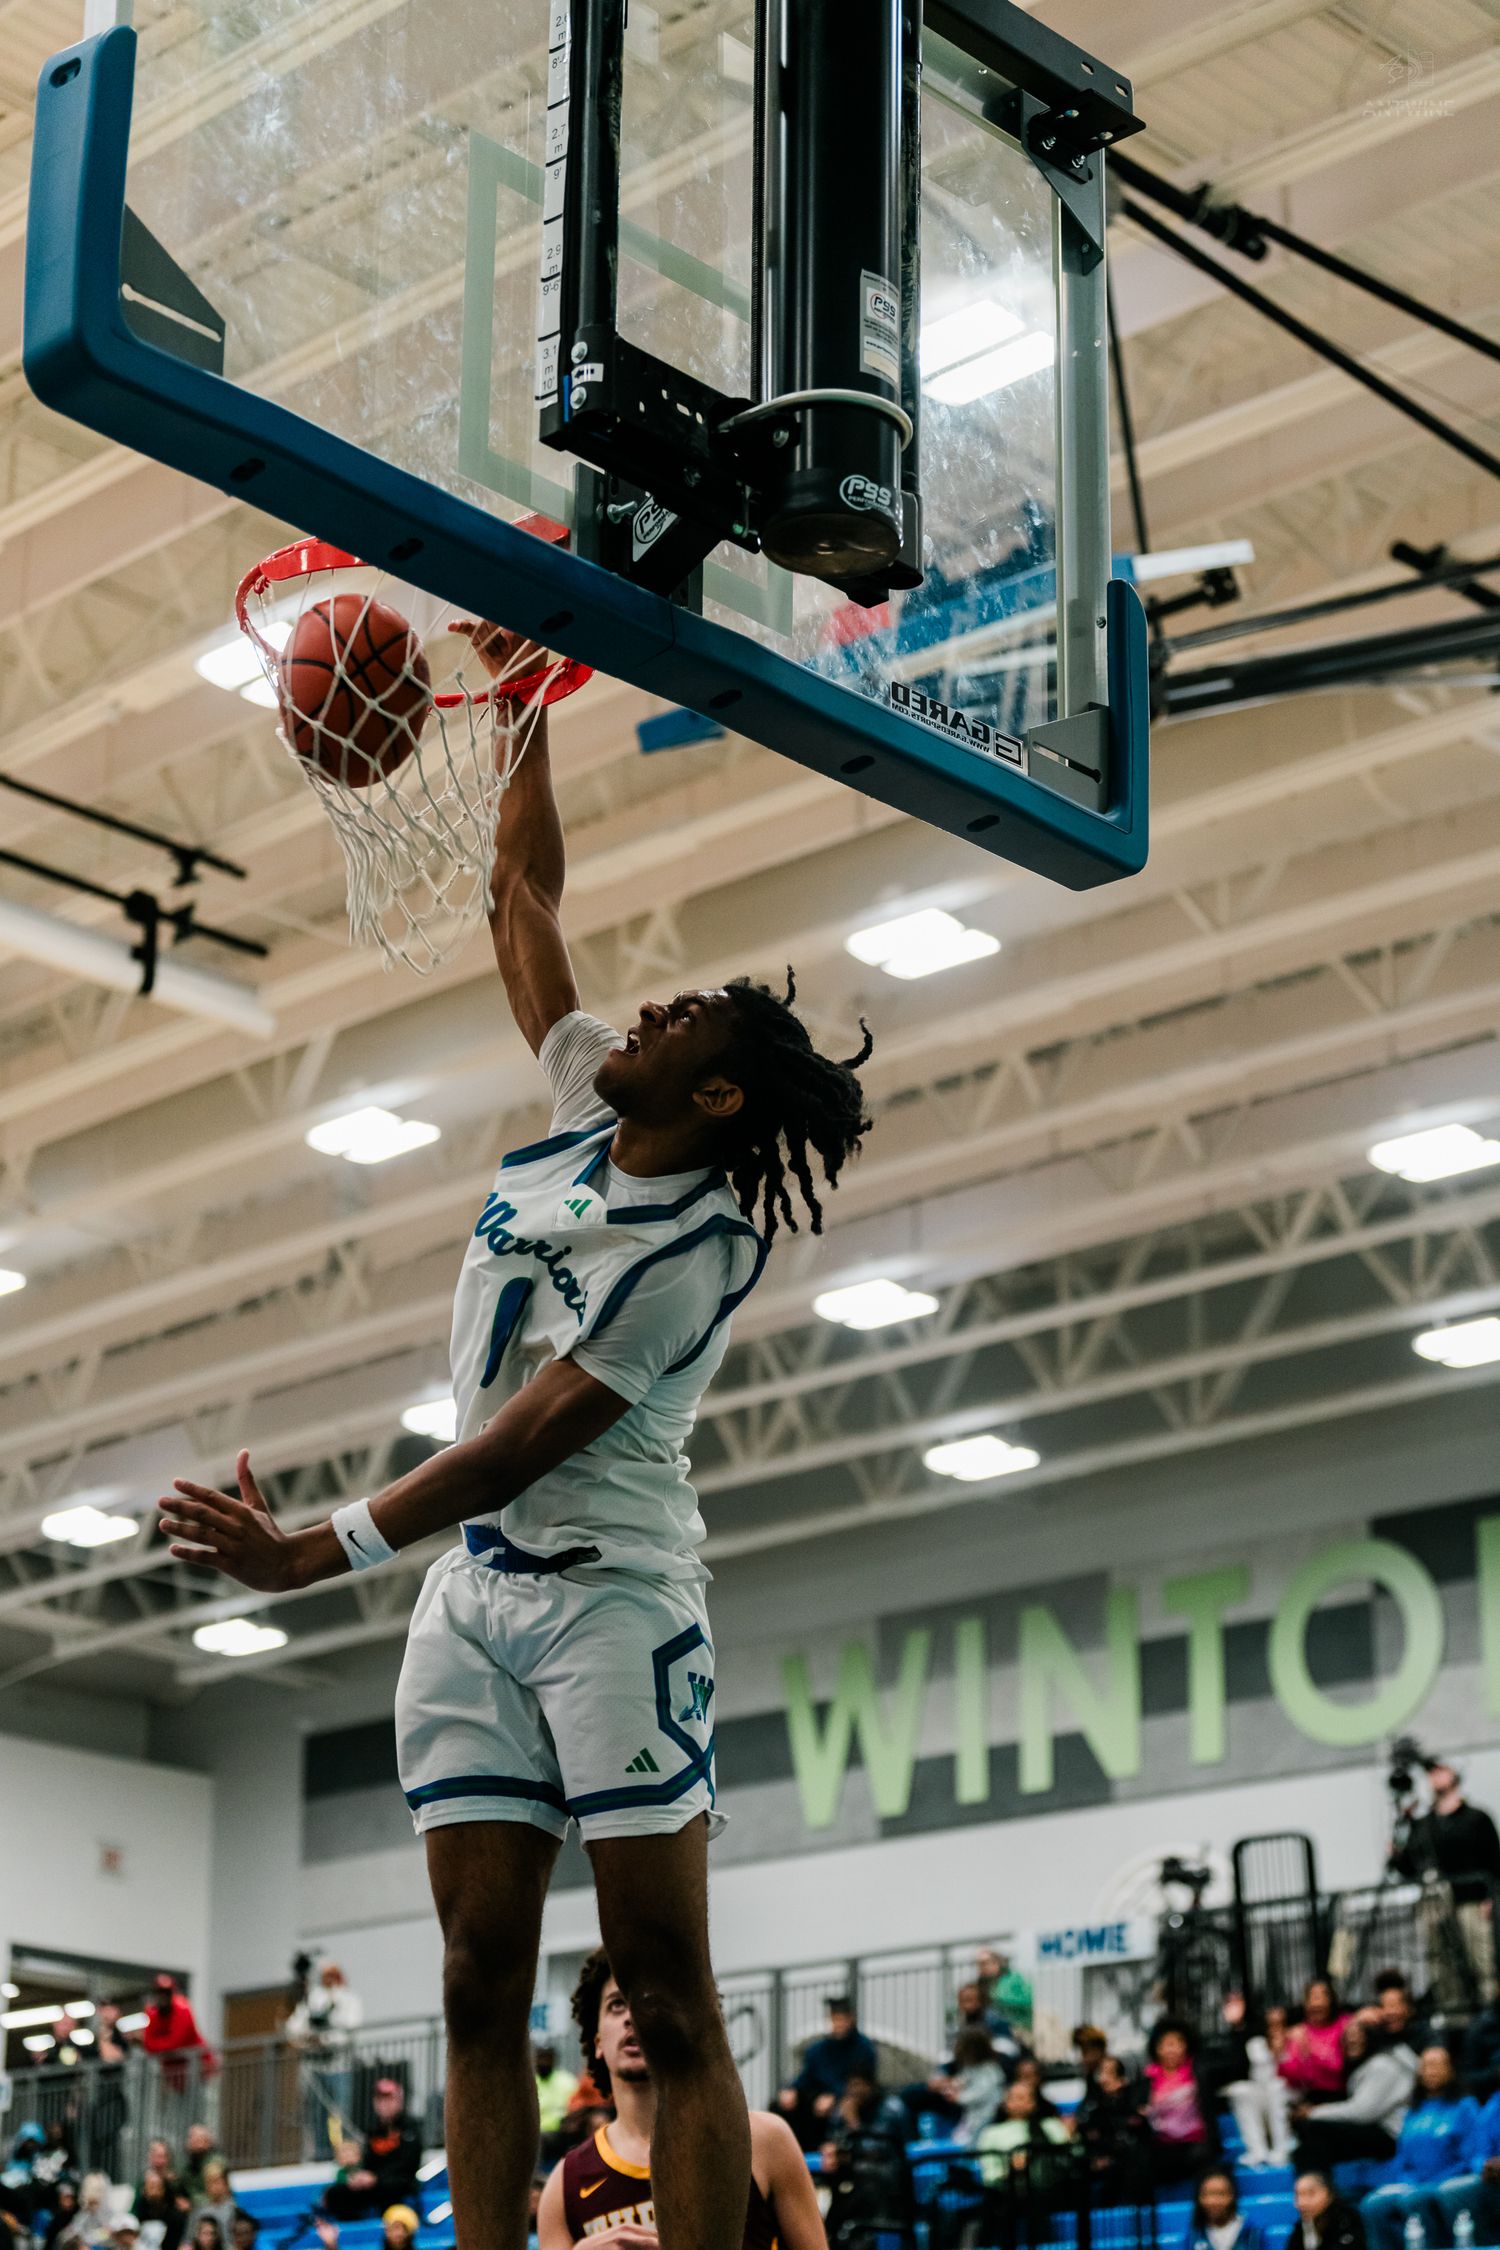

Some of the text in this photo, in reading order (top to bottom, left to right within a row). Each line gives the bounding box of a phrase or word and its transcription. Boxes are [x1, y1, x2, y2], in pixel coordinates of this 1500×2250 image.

[551, 123, 567, 140] 2.7
[554, 143, 563, 154] m
[546, 244, 561, 260] 2.9
[549, 264, 558, 275] m
[544, 365, 554, 376] m
[847, 479, 892, 506] PSS
[781, 1515, 1500, 1829] WINTO
